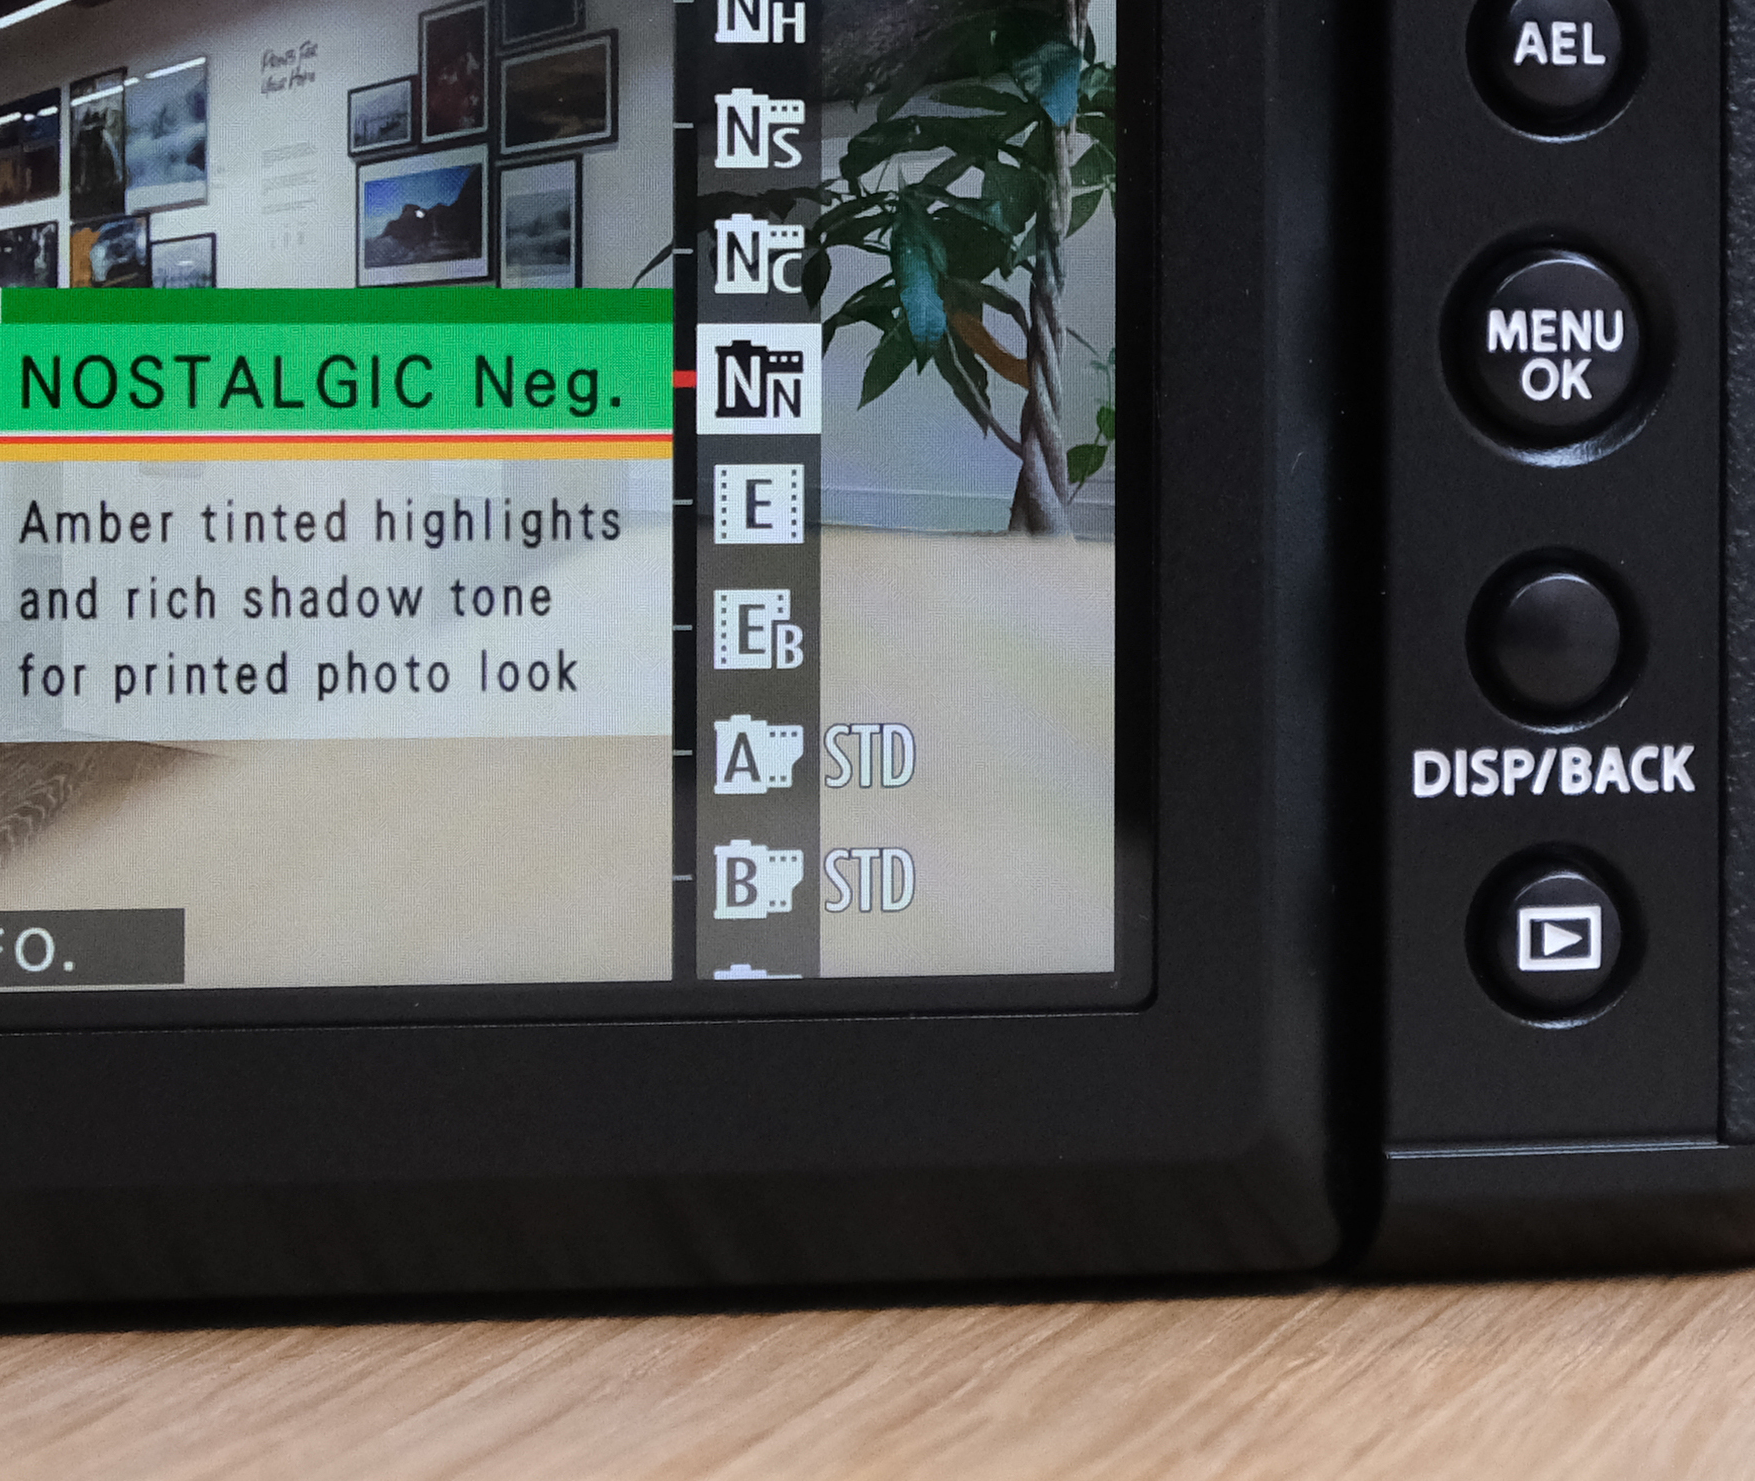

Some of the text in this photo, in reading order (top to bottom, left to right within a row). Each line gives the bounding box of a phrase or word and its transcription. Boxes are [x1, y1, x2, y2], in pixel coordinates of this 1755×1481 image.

[1513, 20, 1607, 67] AEL
[1487, 308, 1625, 355] MENU
[20, 351, 623, 419] NOSTALGIC Neg.
[1520, 356, 1593, 402] OK
[18, 496, 622, 551] Amber tinted highlights
[18, 573, 554, 622] and rich shadow tone
[18, 648, 579, 705] for printed photo look
[823, 722, 917, 789] STD
[1412, 743, 1696, 799] DISP/BACK
[823, 847, 917, 913] STD
